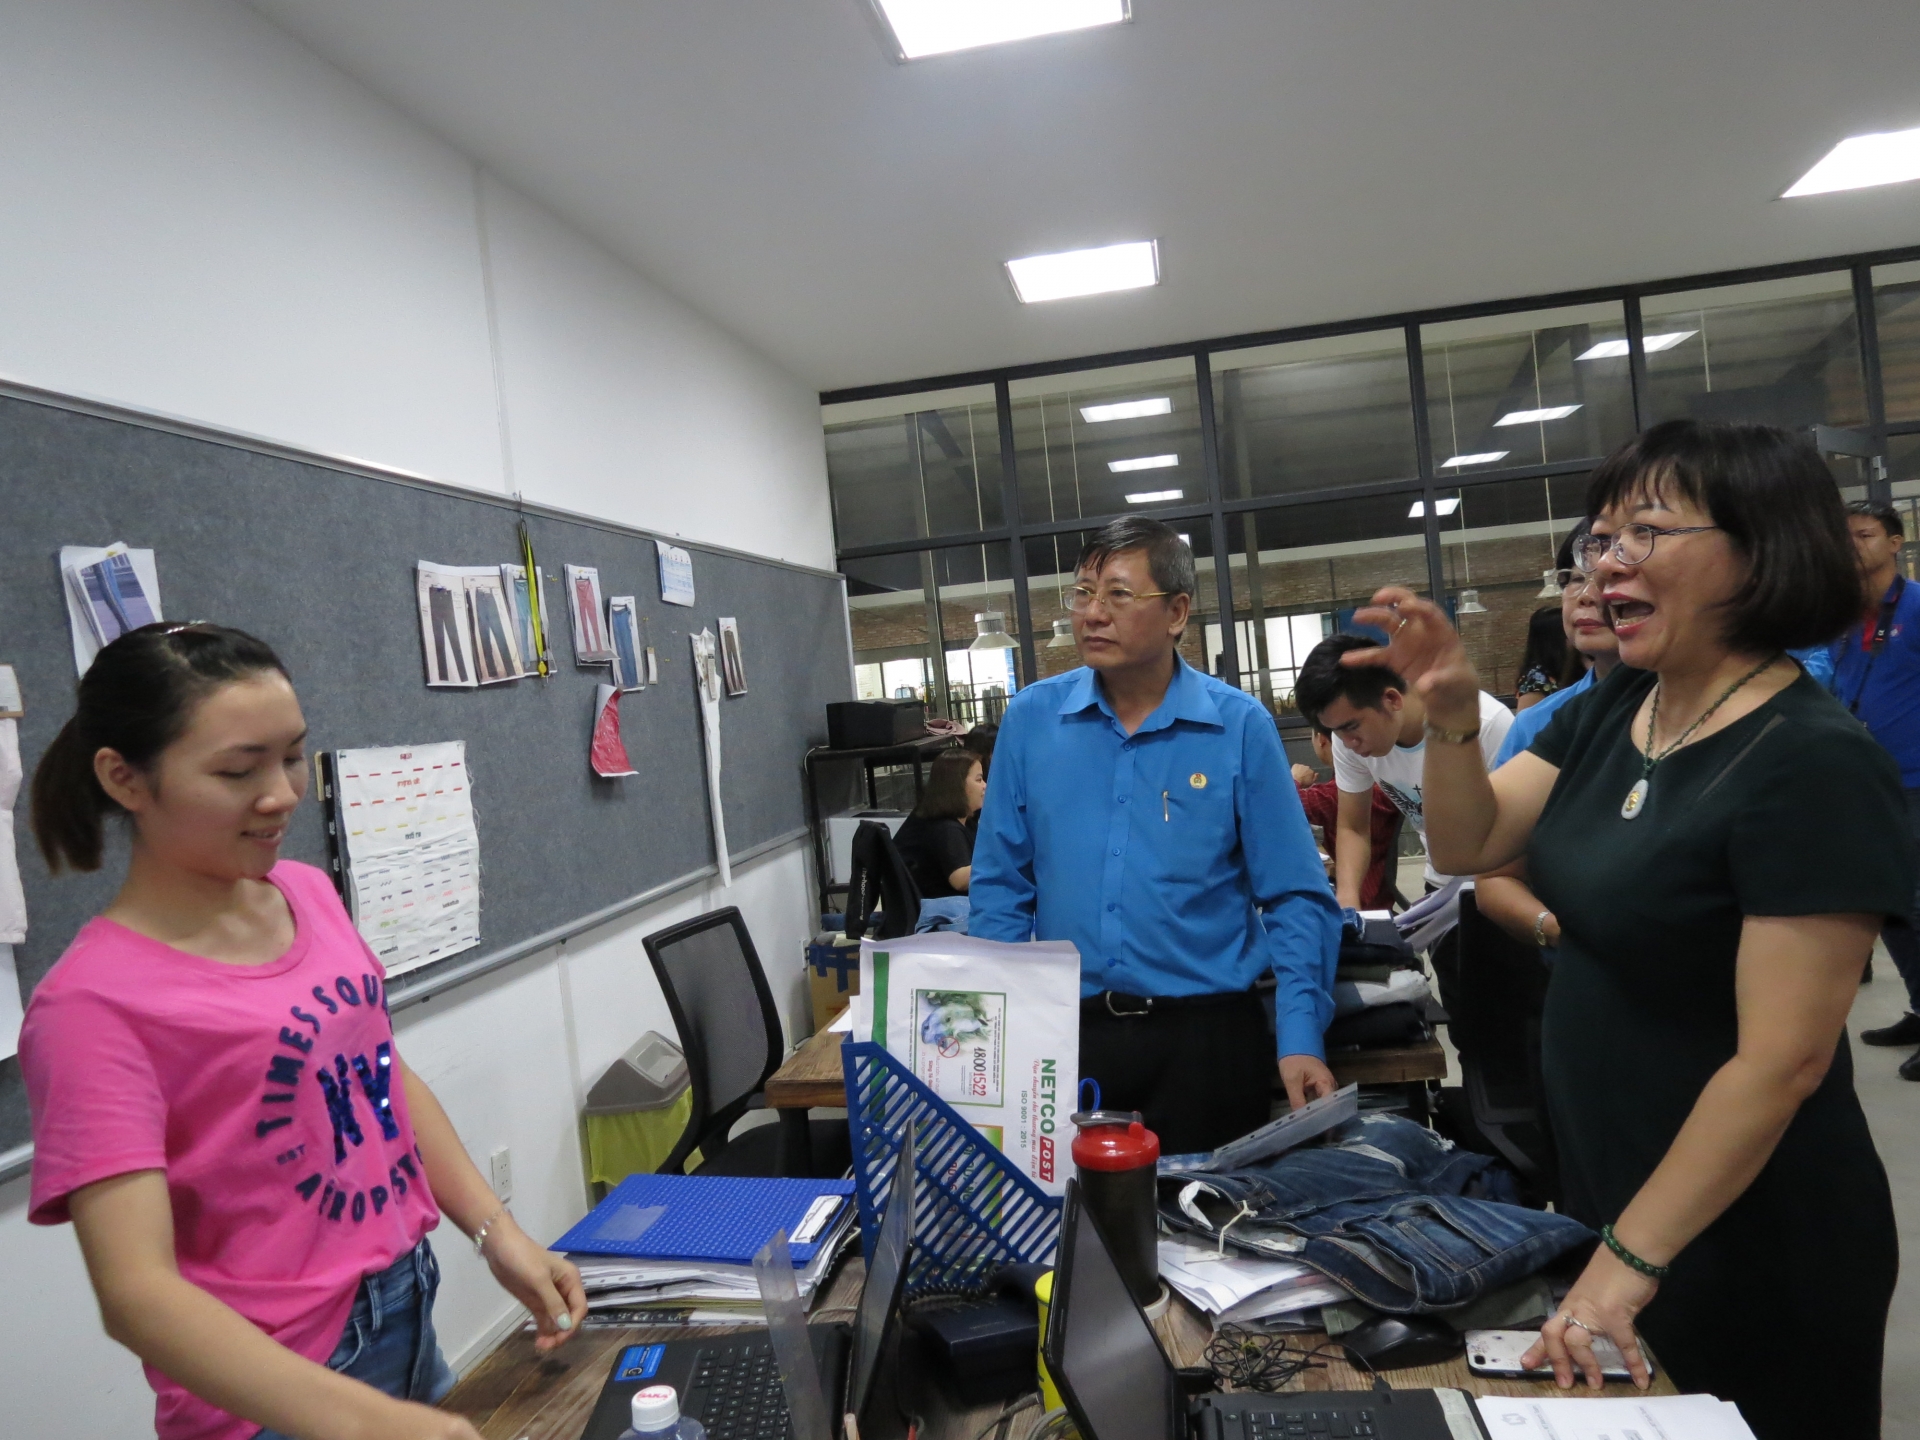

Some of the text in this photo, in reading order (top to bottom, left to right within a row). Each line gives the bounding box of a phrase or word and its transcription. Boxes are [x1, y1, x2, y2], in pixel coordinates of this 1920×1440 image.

[316, 1040, 399, 1165] NY
[1040, 1058, 1056, 1181] NETCO POST
